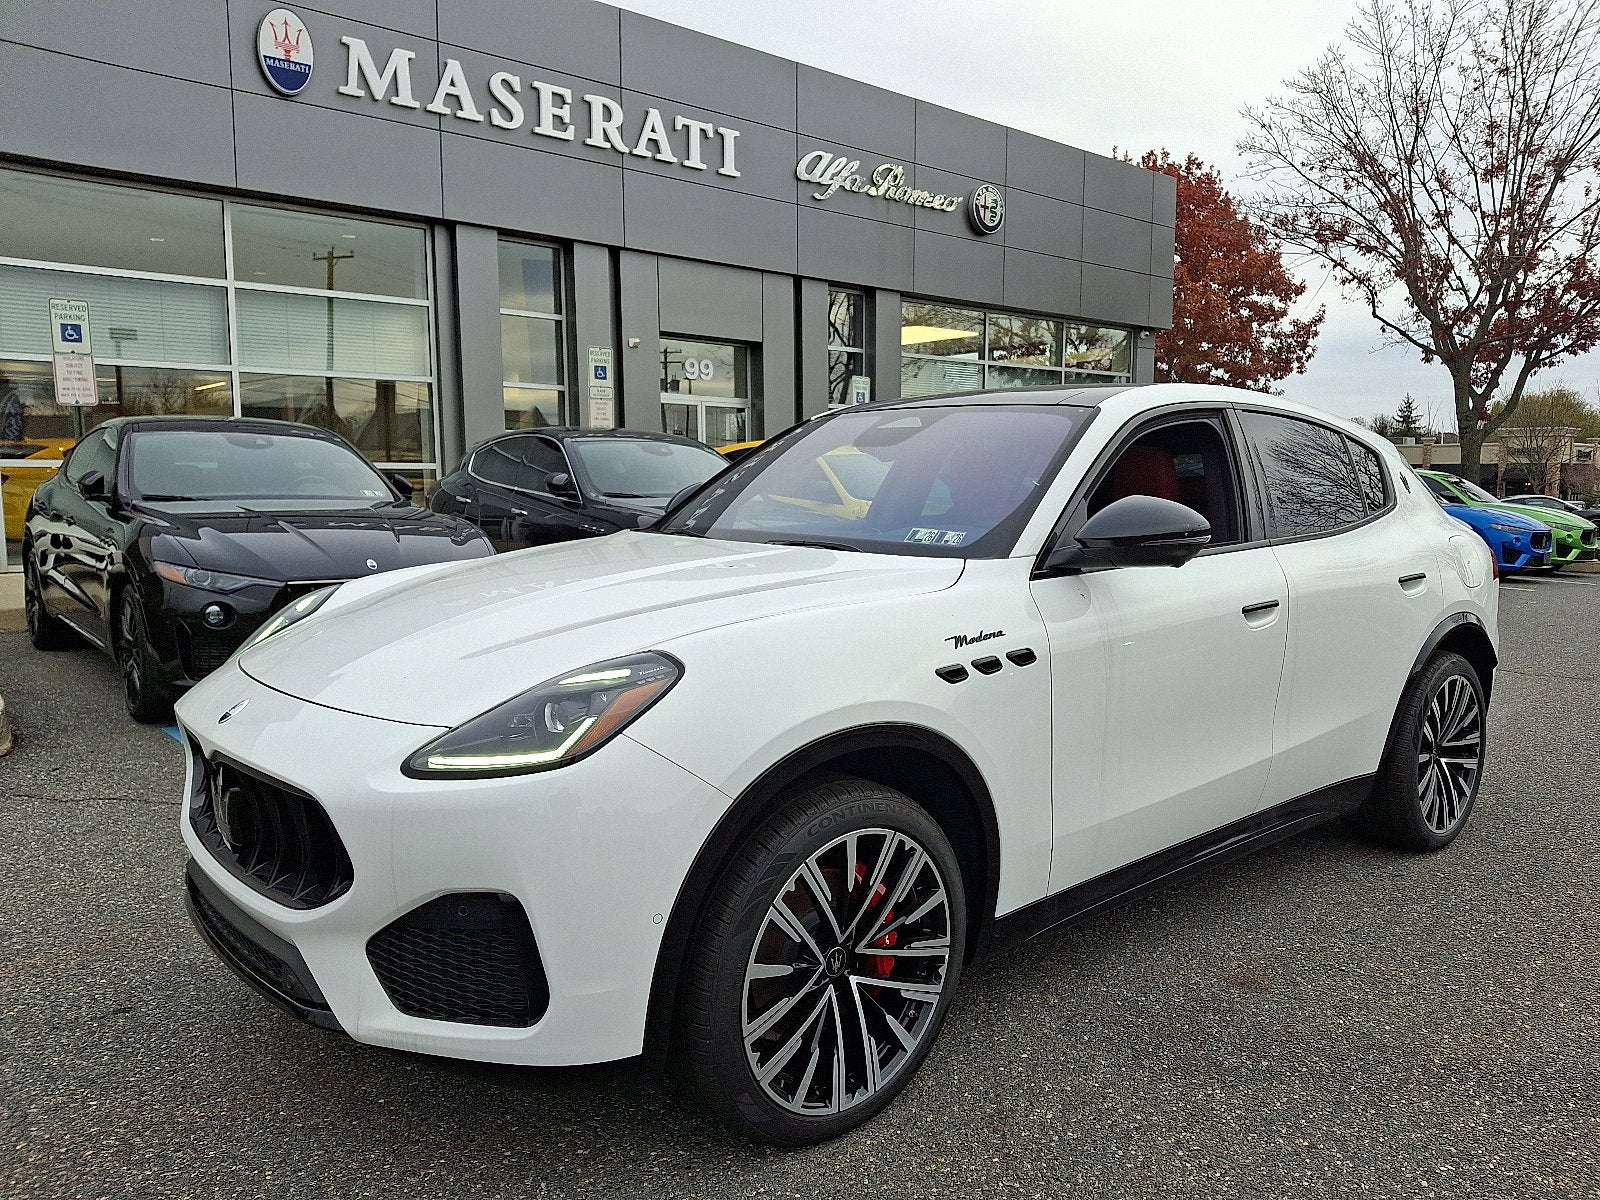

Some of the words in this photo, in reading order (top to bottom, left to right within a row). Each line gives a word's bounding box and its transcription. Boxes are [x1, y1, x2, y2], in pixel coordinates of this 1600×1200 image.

[265, 57, 310, 74] MASERATI
[337, 35, 741, 178] MASERATI
[796, 151, 870, 200] Alfa
[867, 163, 963, 212] Romeo
[51, 303, 87, 313] RESERVED
[54, 313, 85, 321] PARKING
[684, 357, 714, 381] 99
[944, 629, 1006, 649] Modena
[806, 801, 919, 838] CONTINENTA
